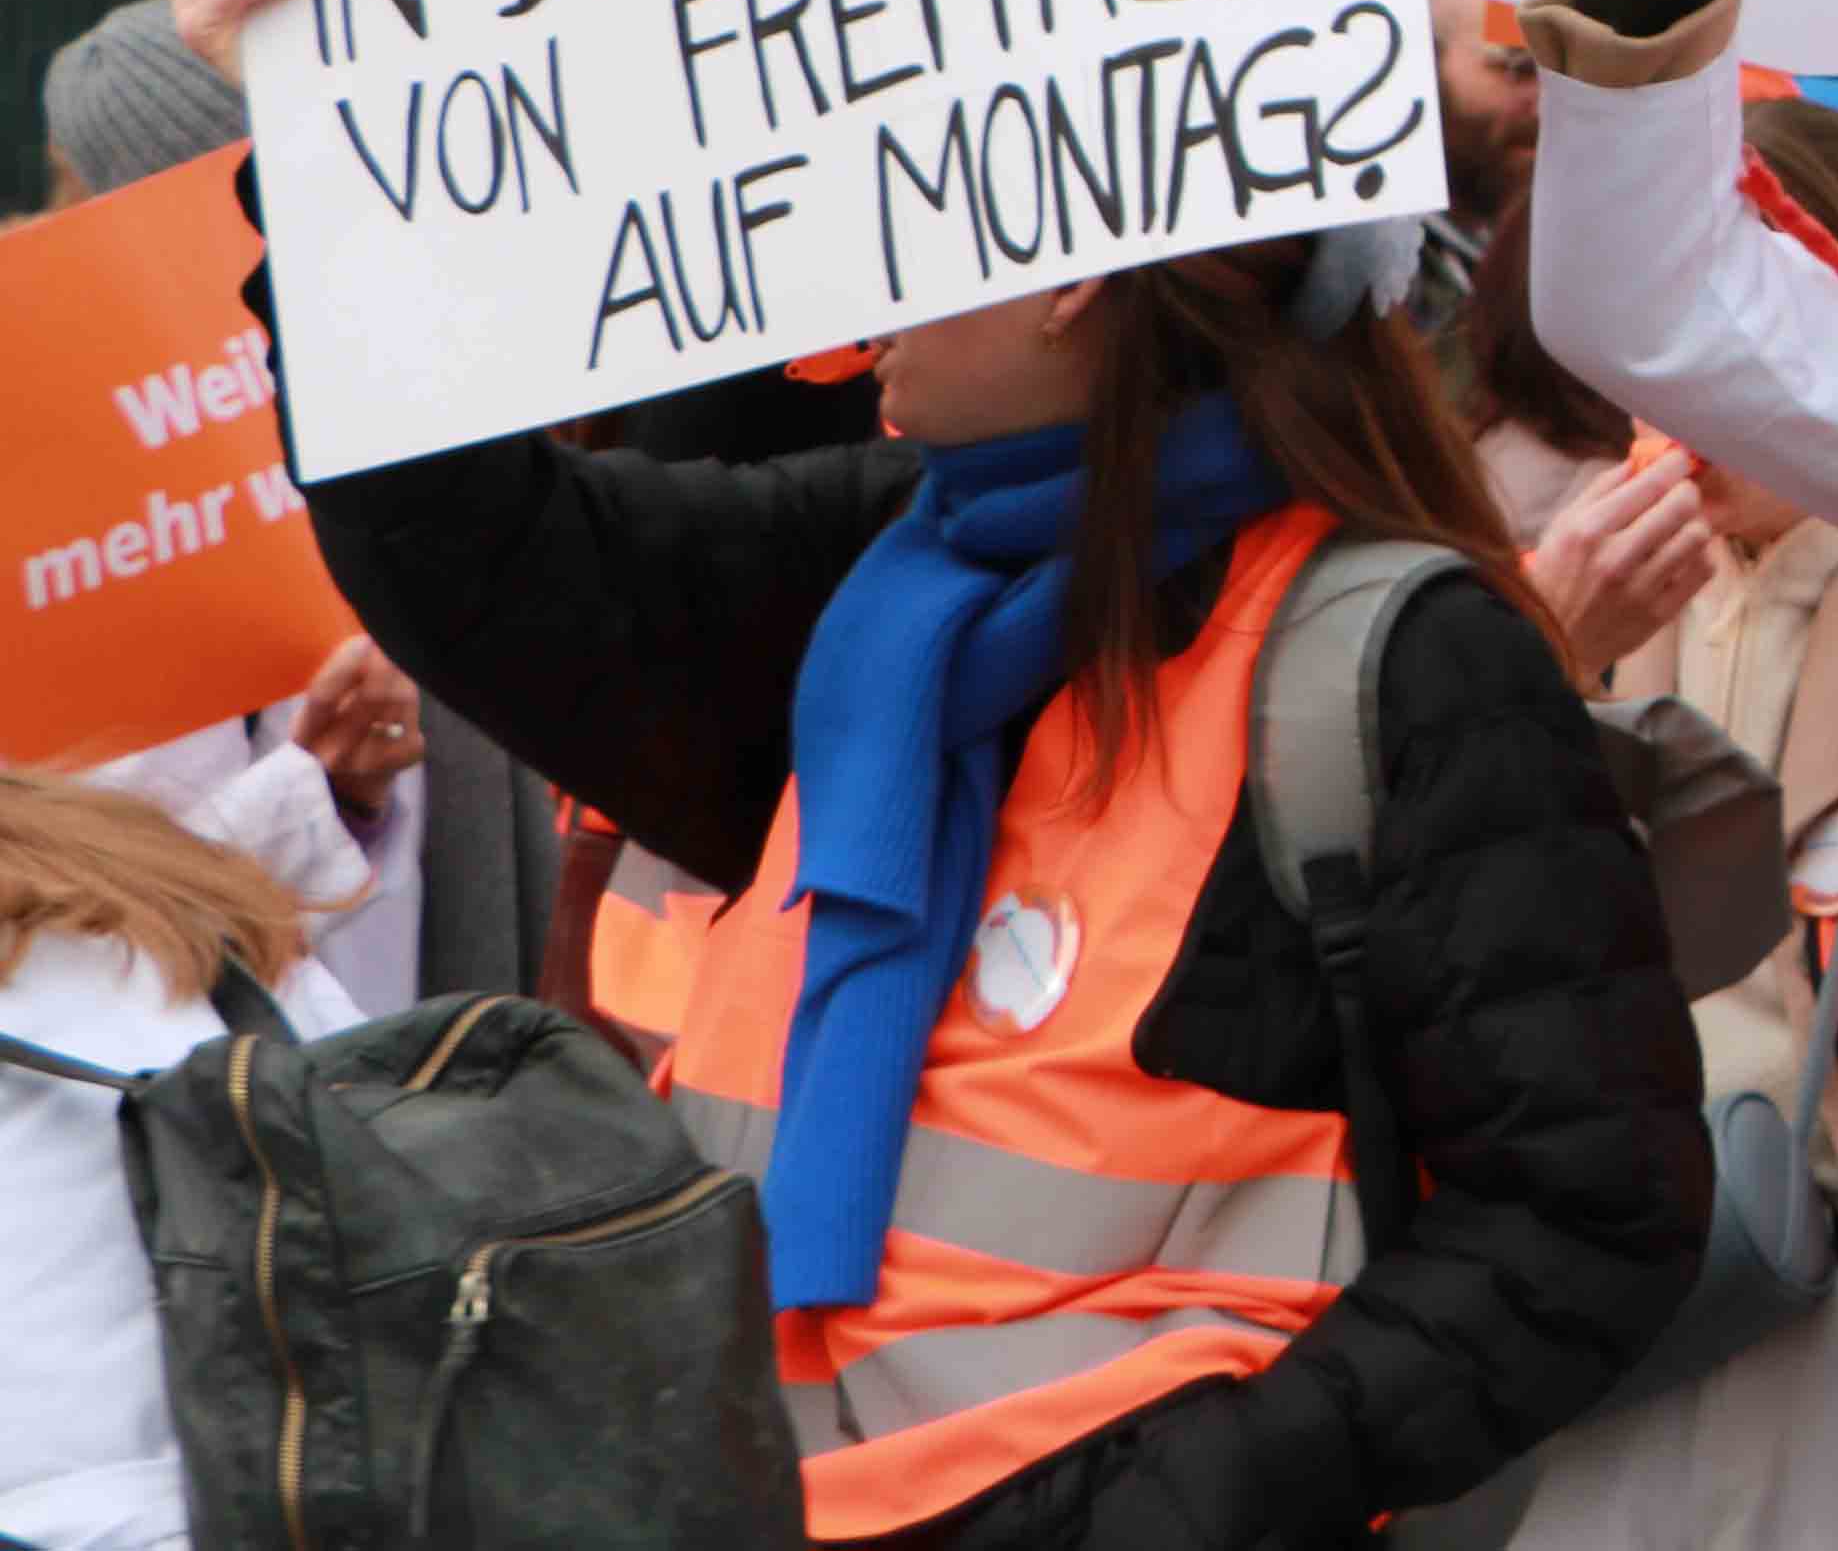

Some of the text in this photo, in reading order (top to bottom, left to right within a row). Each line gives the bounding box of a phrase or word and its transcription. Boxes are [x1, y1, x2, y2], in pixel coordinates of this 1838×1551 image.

[336, 37, 580, 221] VON
[587, 0, 1424, 370] AUF MONTAG?
[22, 482, 236, 612] mehr
